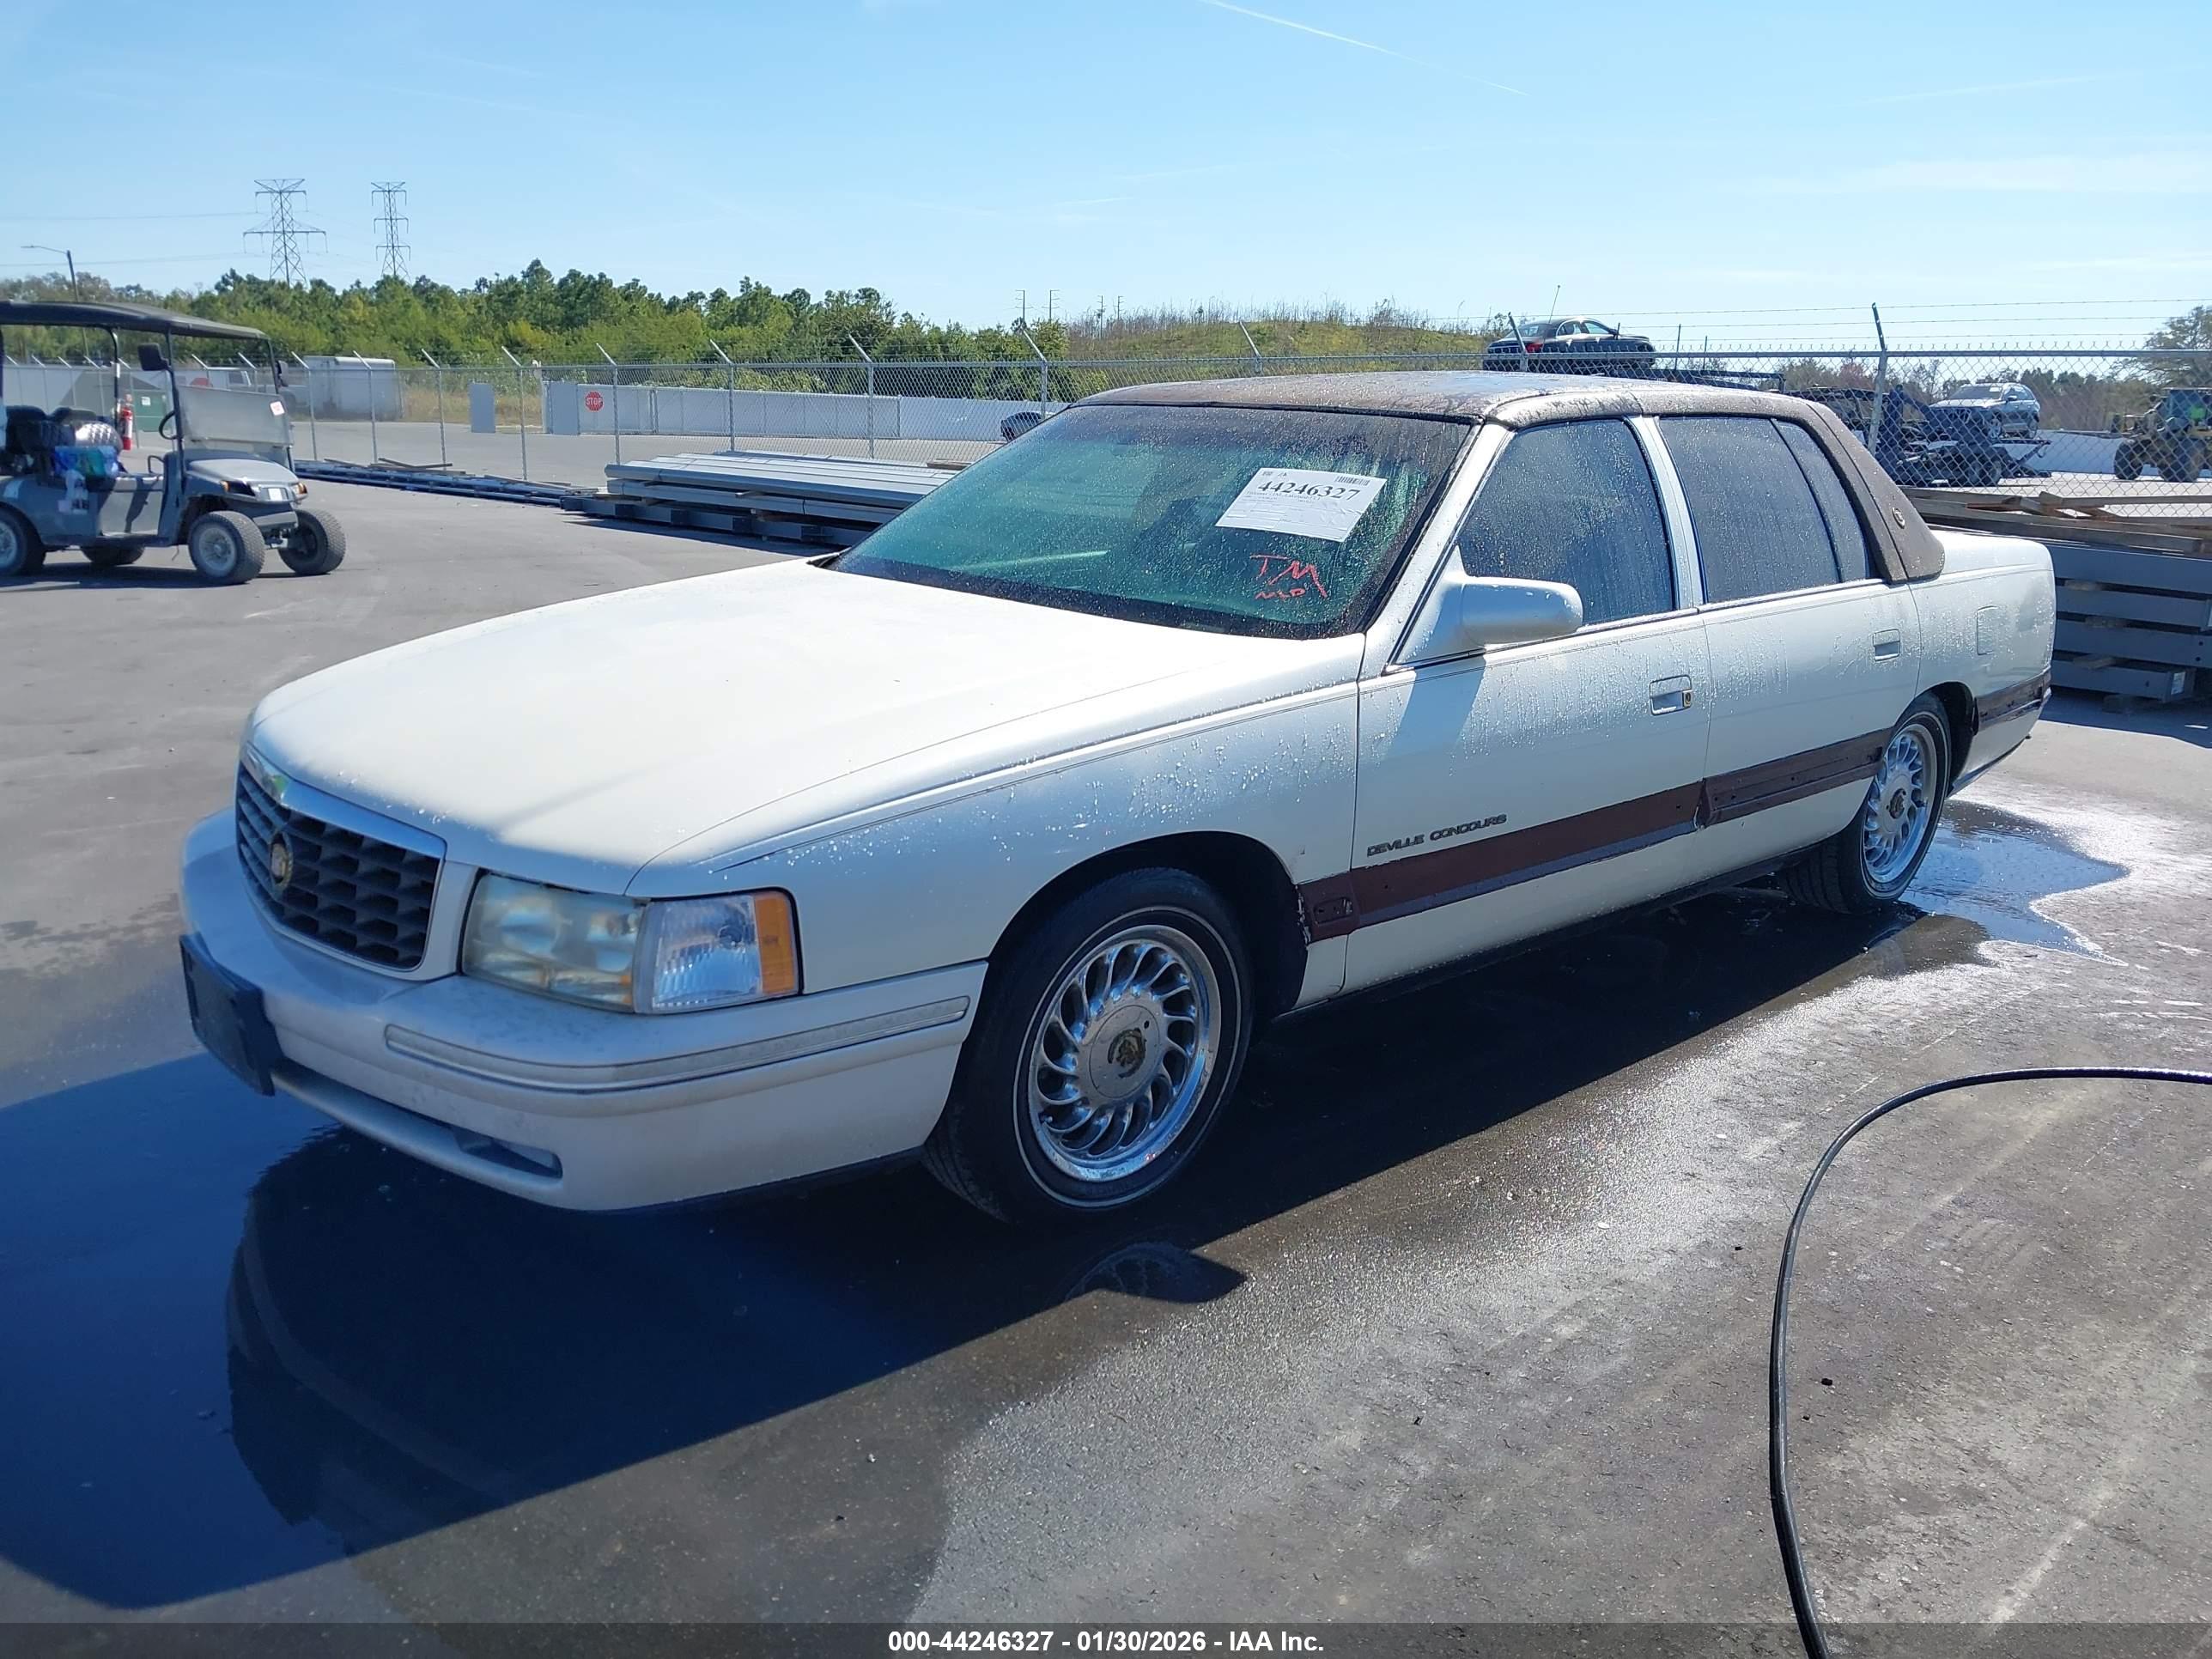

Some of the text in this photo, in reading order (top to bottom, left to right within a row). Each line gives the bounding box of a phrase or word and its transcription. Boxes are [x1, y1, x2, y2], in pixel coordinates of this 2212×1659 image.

[586, 397, 604, 406] STOP
[1257, 480, 1360, 500] 44246327
[1367, 813, 1507, 856] DEVILLE CONCOURS
